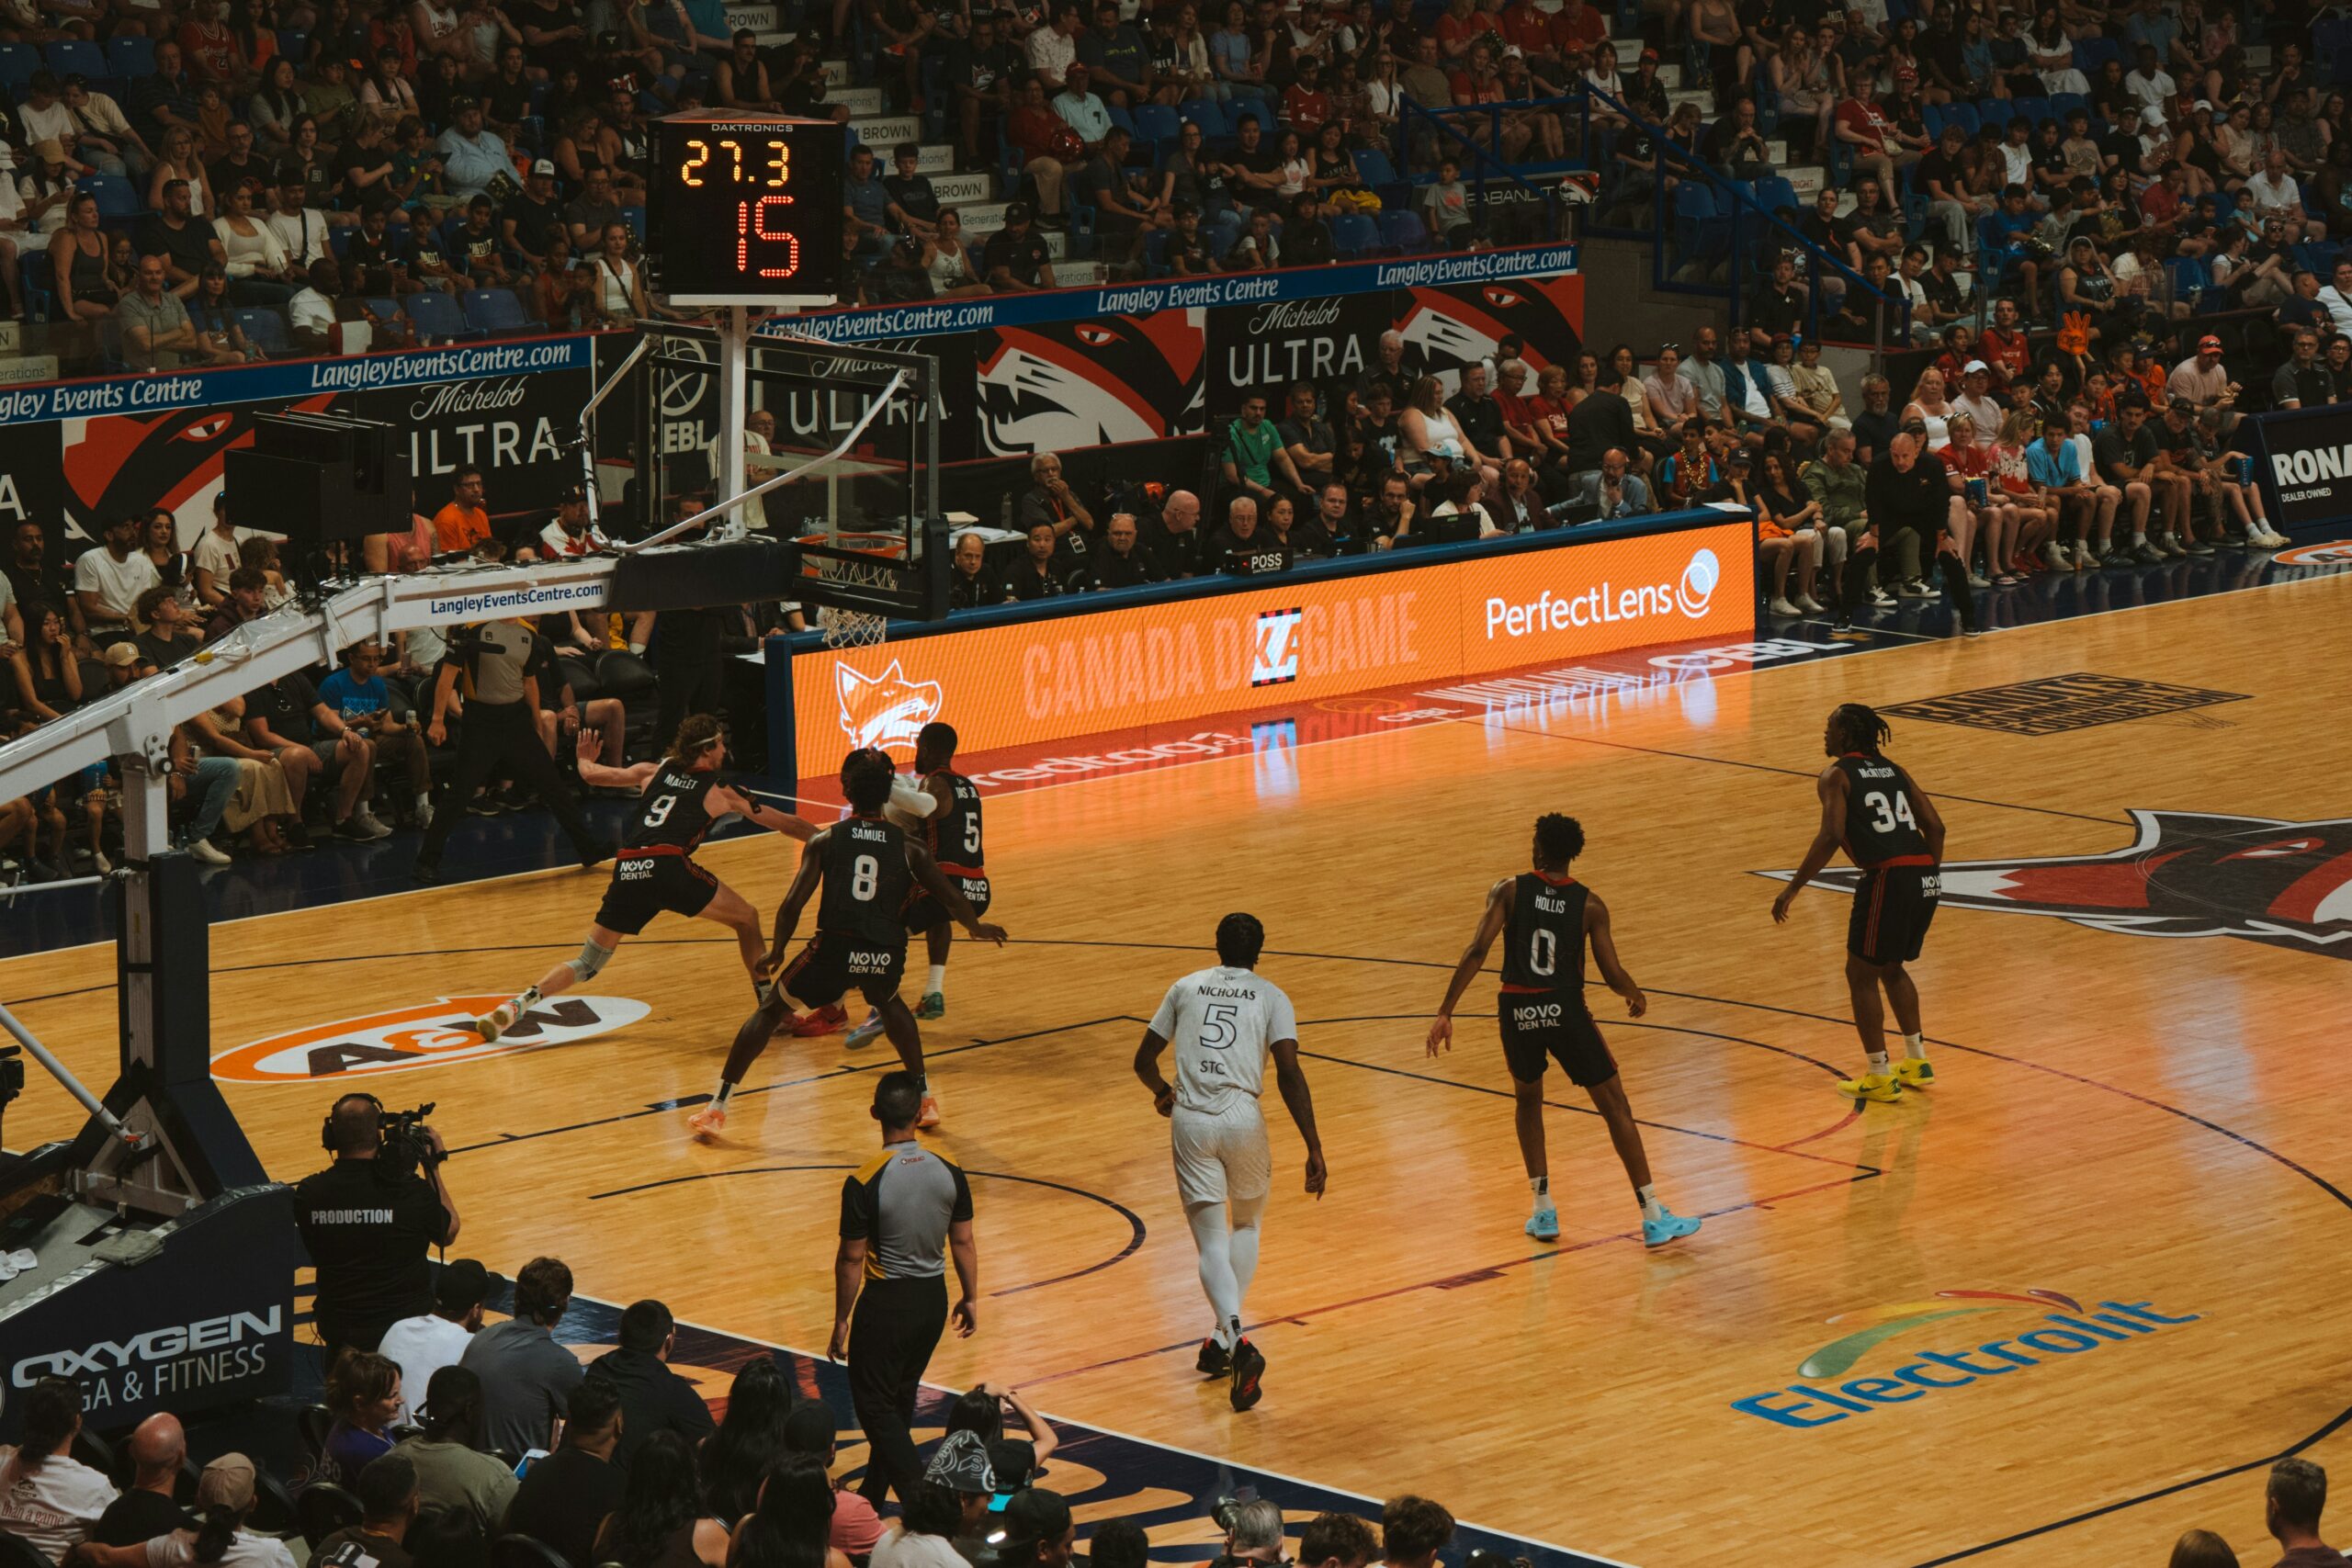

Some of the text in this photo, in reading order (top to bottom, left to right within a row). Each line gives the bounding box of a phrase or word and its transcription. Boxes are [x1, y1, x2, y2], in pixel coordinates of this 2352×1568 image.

[729, 13, 769, 27] ROWN
[711, 123, 794, 132] DAKTRONICS
[863, 124, 911, 140] BROWN
[681, 140, 790, 187] 27.3
[934, 183, 982, 198] BROWN
[737, 195, 799, 277] 15
[1376, 249, 1572, 288] LangleyEventsCentre.com
[1097, 276, 1279, 314] Langley Events Centre
[1249, 297, 1343, 335] Michelob
[311, 344, 571, 389] LangleyEventsCentre.com
[1228, 333, 1365, 388] ULTRA
[52, 384, 124, 413] Events
[130, 377, 202, 405] Centre
[411, 375, 528, 421] Michelob
[654, 419, 710, 454] EBL
[2281, 487, 2332, 503] DEALER OWNED
[1251, 553, 1283, 570] POSS
[431, 584, 603, 615] LangleyEventsCentre.com
[1486, 581, 1673, 640] PerfectLens
[1303, 591, 1419, 677] GAME
[1023, 621, 1204, 721] CANADA
[1647, 637, 1855, 670] CEBL
[1891, 674, 2146, 721] BANDITS
[644, 795, 677, 828] 9
[1864, 790, 1918, 833] 34
[852, 827, 888, 843] SAMUEL
[964, 811, 980, 853] 5
[619, 859, 654, 873] NOVO
[620, 870, 652, 881] DENTAL
[852, 854, 878, 902] 8
[1534, 895, 1566, 914] HOLLIS
[848, 951, 891, 965] NOVO
[1530, 928, 1556, 976] 0
[1197, 985, 1256, 1001] NICHOLAS
[1199, 1003, 1238, 1050] 5
[1513, 1003, 1562, 1021] NOVO
[1200, 1060, 1226, 1075] STC
[311, 1208, 393, 1225] PRODUCTION
[12, 1303, 281, 1389] OXYGEN
[1731, 1299, 2200, 1428] Electrolit
[122, 1370, 143, 1403] &
[154, 1342, 266, 1396] FITNESS
